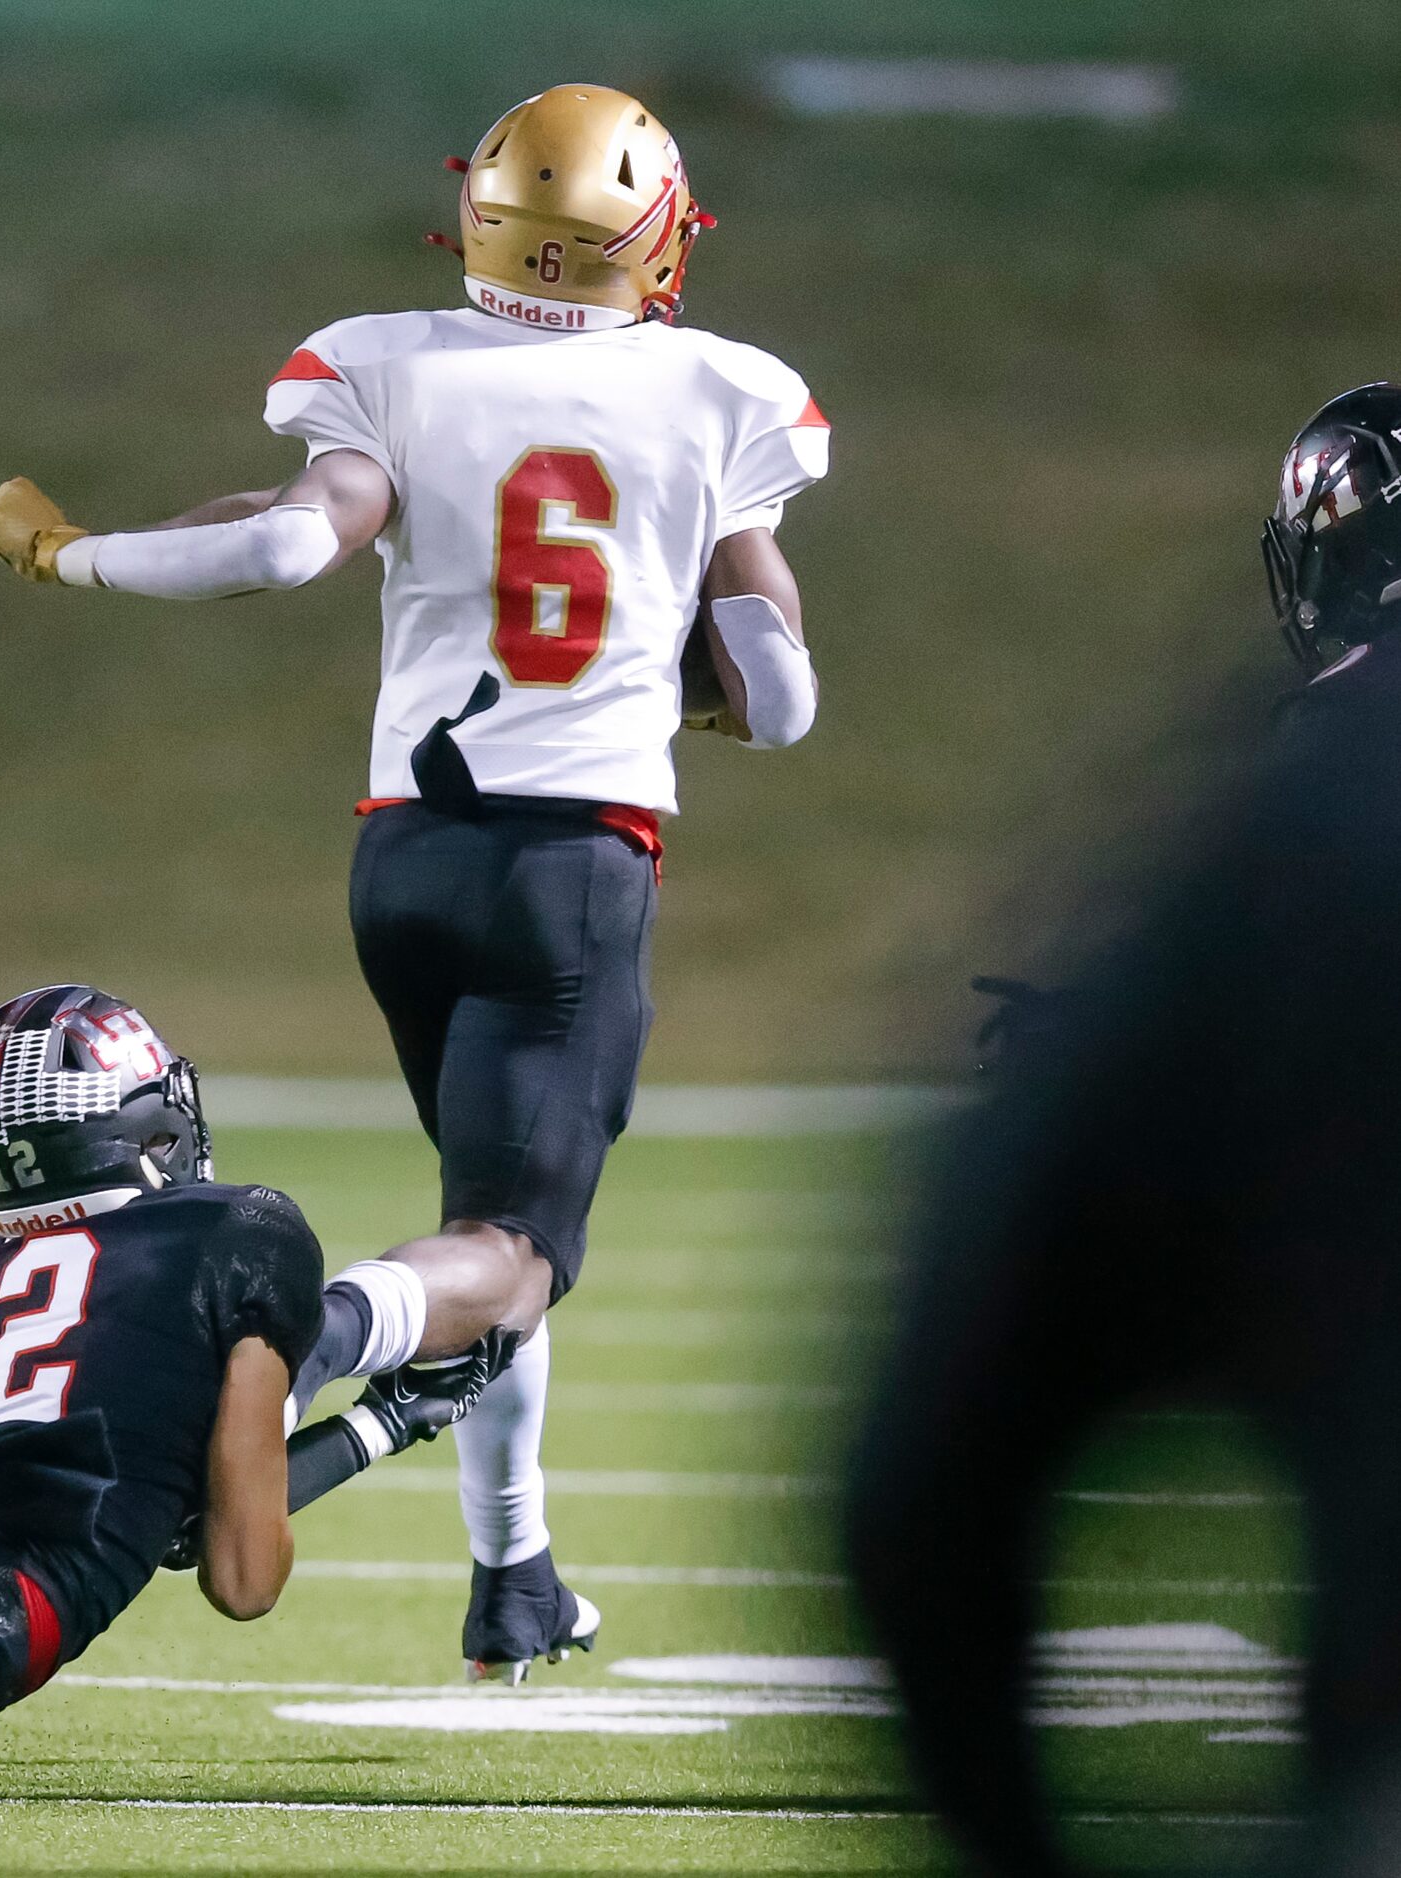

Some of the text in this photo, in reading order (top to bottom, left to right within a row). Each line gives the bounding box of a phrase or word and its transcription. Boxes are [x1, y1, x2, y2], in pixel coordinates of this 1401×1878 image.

[538, 241, 565, 284] 6
[482, 289, 585, 328] Riddell
[489, 445, 618, 690] 6
